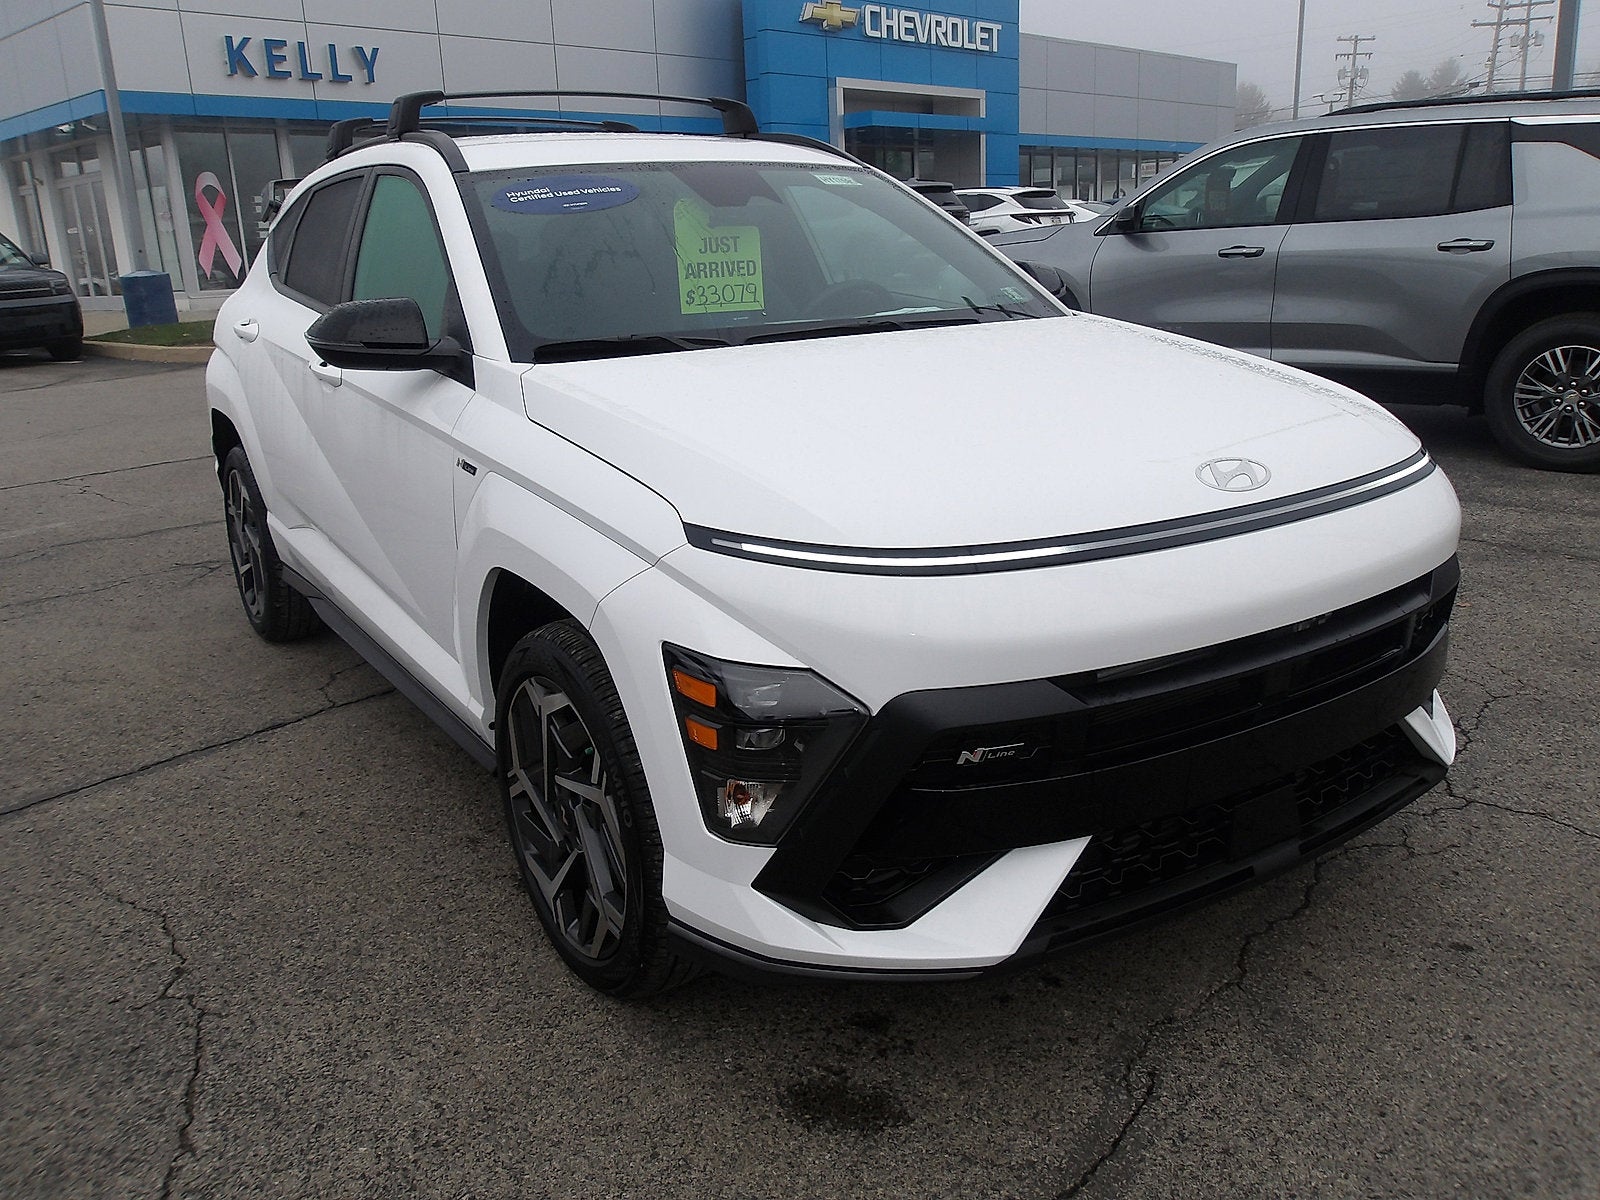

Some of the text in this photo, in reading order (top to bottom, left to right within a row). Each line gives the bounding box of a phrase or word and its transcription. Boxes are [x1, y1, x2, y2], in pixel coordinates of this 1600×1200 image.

[862, 4, 1002, 52] CHEVROLET
[224, 34, 379, 84] KELLY
[506, 186, 550, 198] Hyundai
[510, 186, 622, 203] Certified Used Vehicles
[698, 236, 740, 254] JUST
[685, 260, 756, 279] ARRIVED
[957, 747, 984, 764] N
